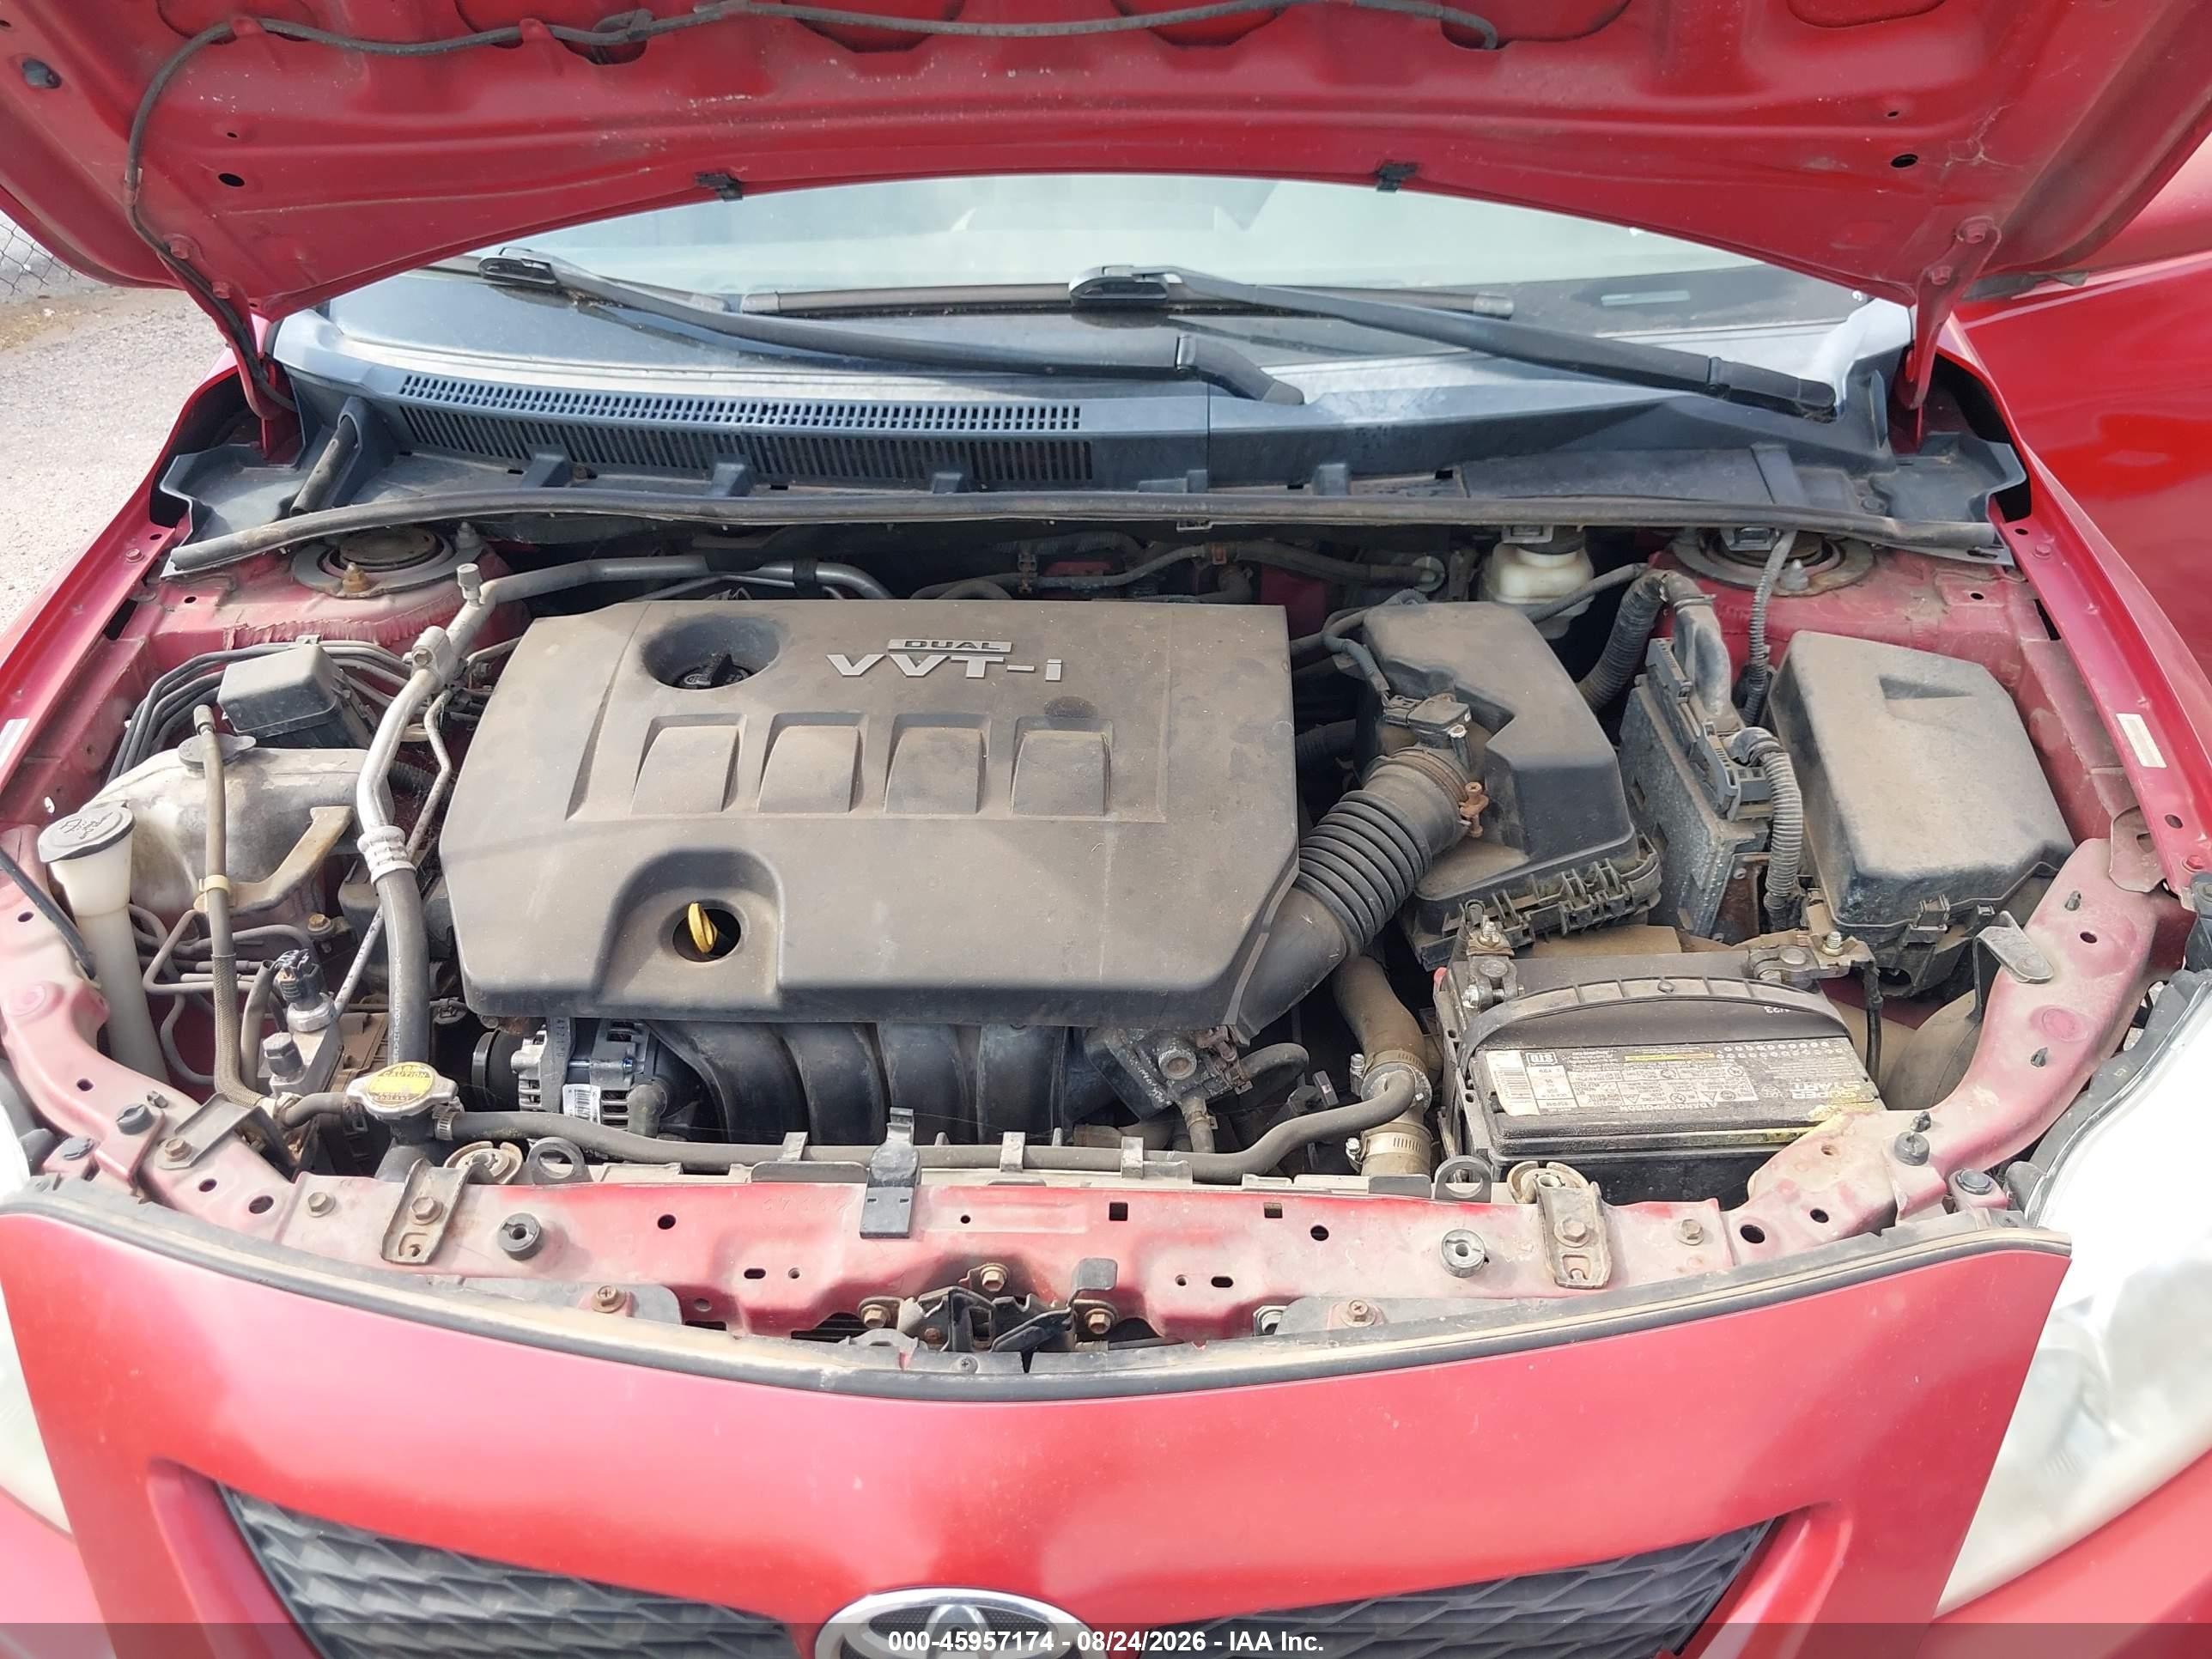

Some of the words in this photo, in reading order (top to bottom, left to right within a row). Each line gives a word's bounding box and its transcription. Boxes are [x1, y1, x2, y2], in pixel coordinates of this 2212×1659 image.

[904, 640, 1001, 651] DUAL
[826, 653, 1064, 683] VVT-i
[1789, 1080, 1861, 1091] START
[1791, 1091, 1856, 1099] SUPER
